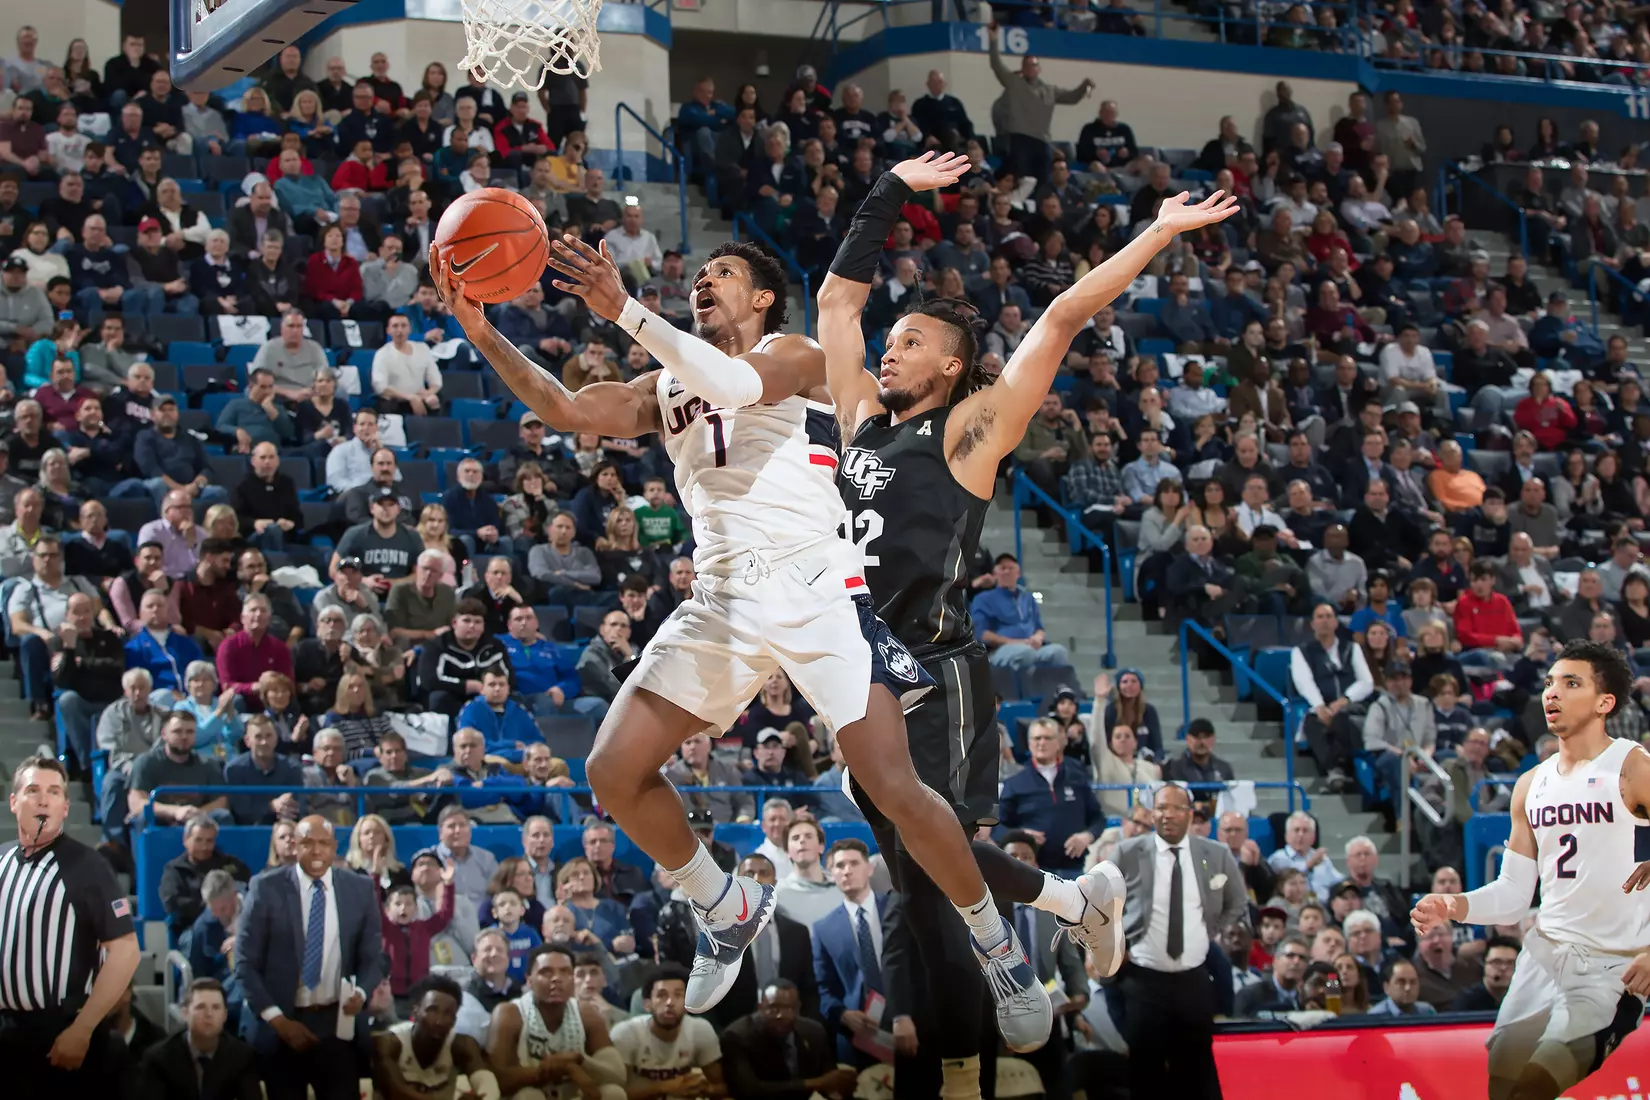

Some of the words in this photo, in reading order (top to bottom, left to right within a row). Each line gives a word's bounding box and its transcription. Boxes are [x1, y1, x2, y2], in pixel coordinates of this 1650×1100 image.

[704, 413, 727, 468] 1
[842, 447, 897, 500] UCF
[364, 548, 409, 566] UCONN
[1529, 802, 1615, 830] UCONN
[1556, 833, 1578, 879] 2
